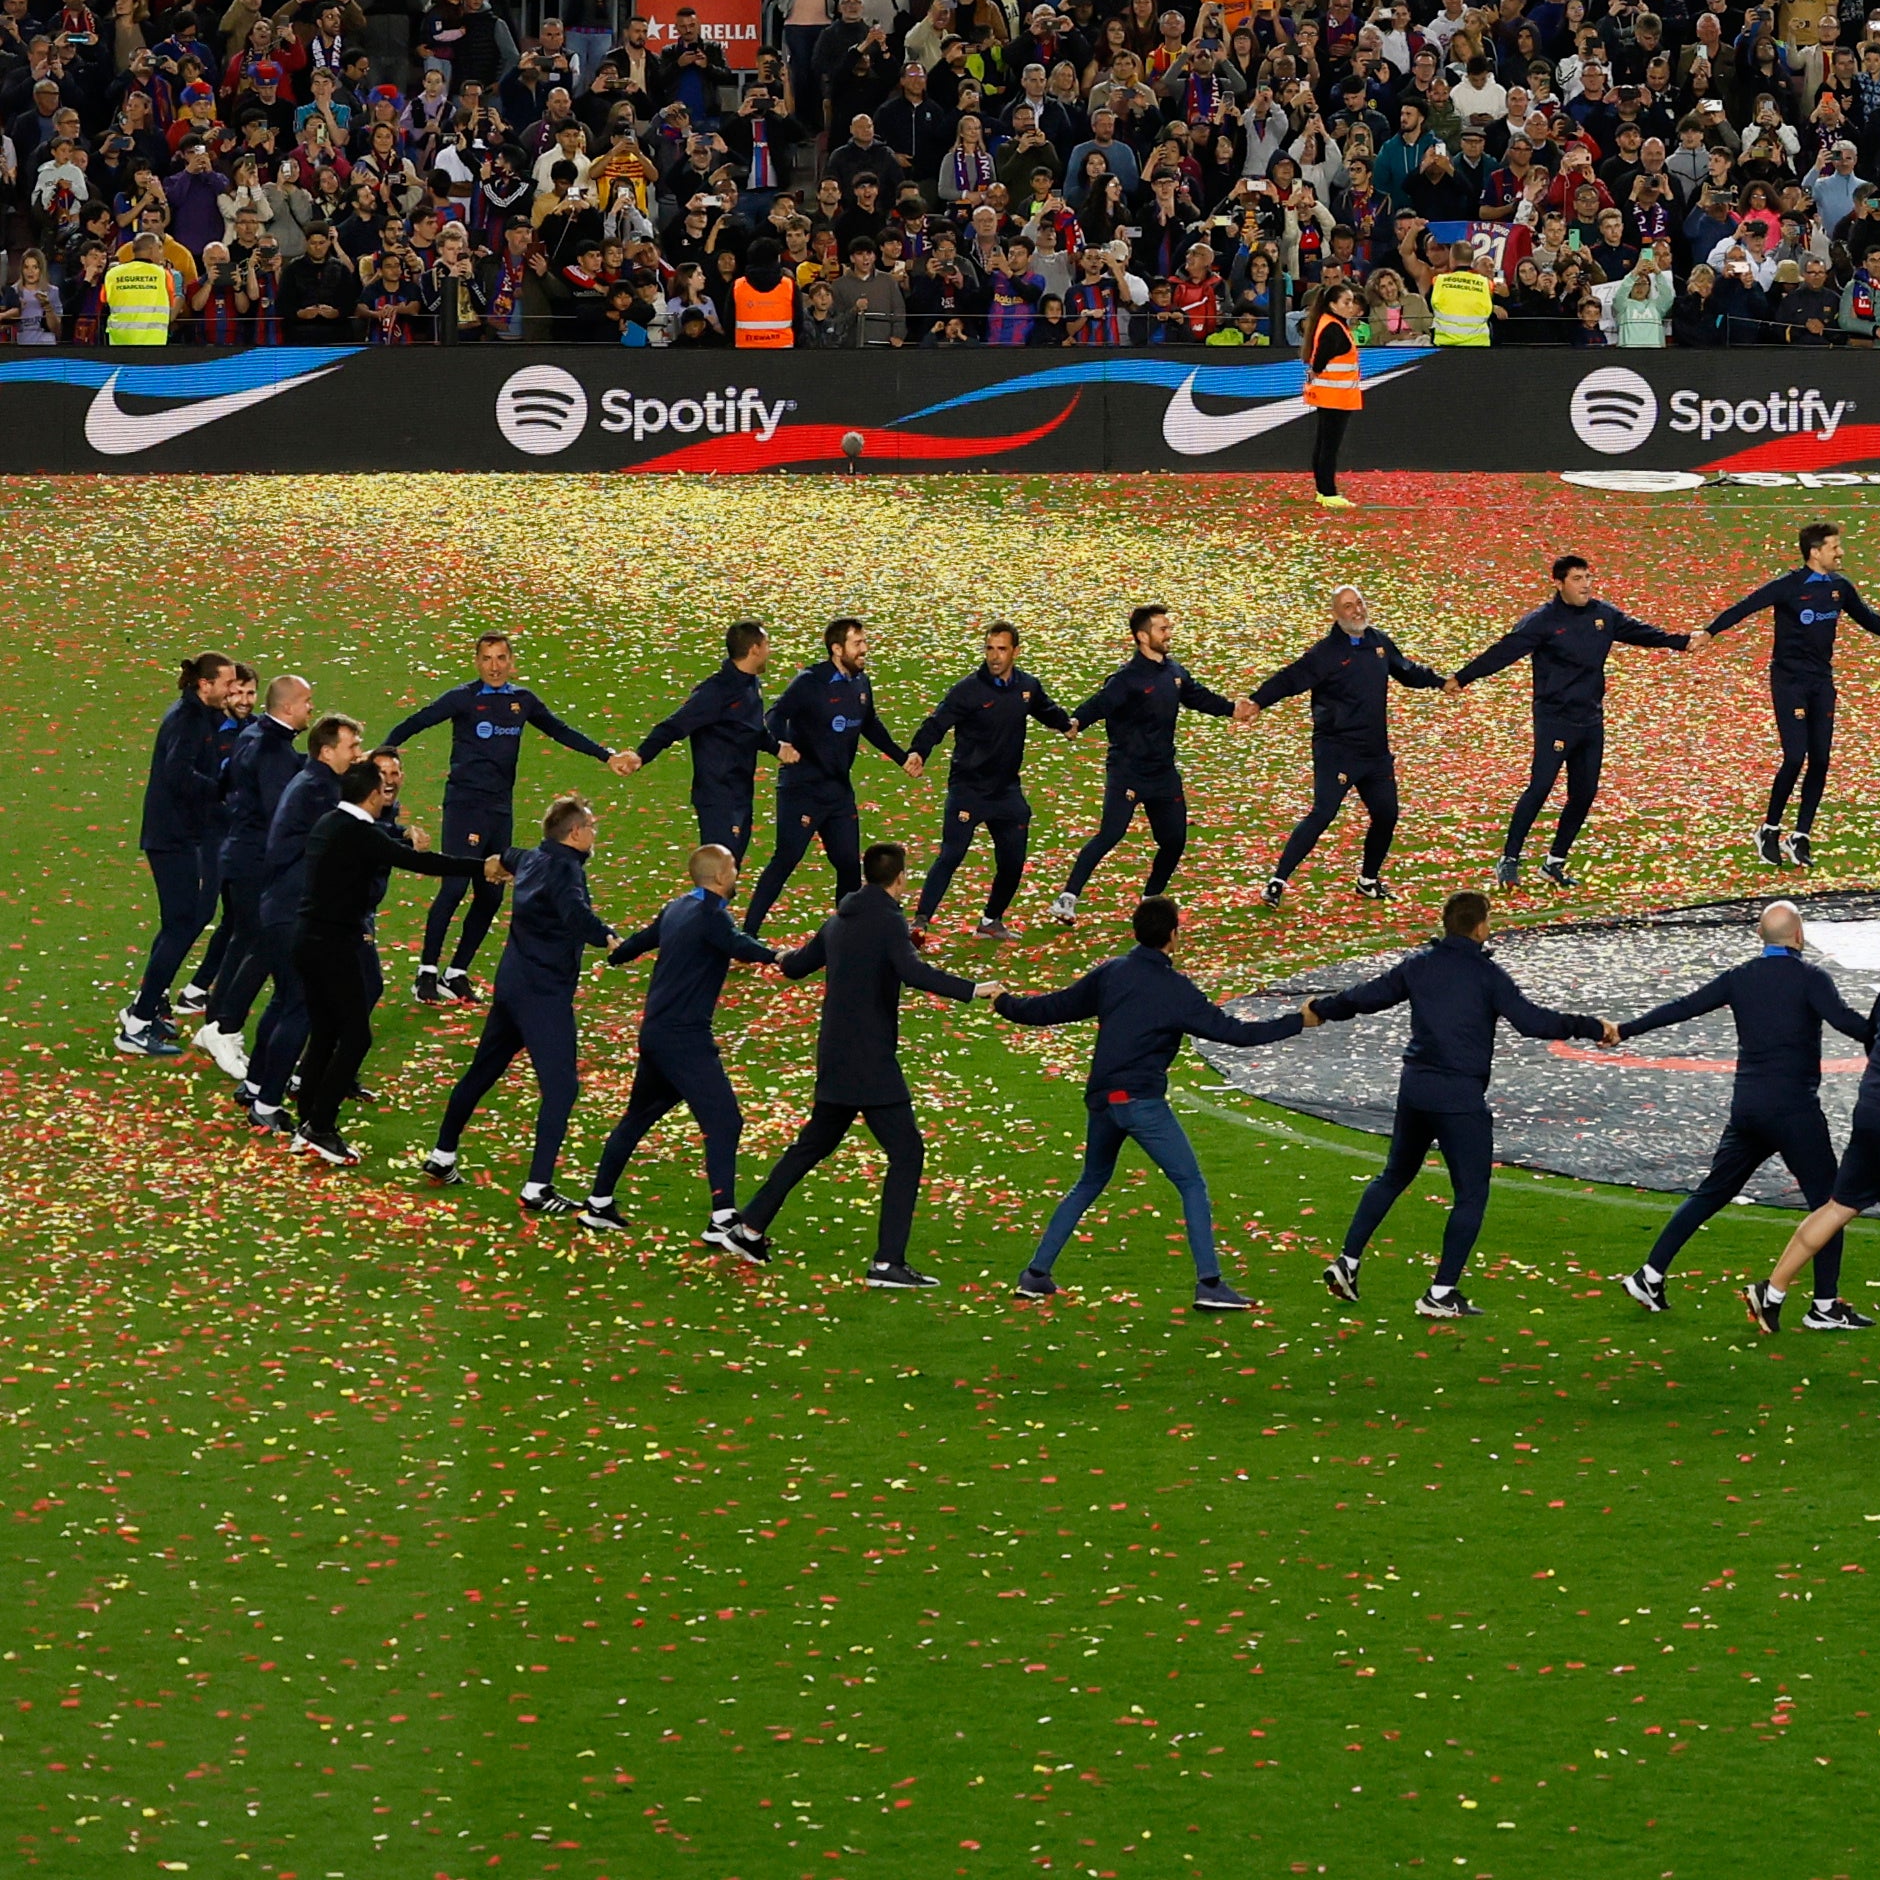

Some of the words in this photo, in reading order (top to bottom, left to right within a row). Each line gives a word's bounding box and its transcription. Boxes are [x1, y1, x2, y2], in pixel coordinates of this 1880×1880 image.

[667, 21, 758, 40] ERELLA
[1471, 233, 1505, 261] 21
[117, 275, 159, 284] SEGURETAT
[601, 387, 786, 442] Spotify
[1669, 387, 1846, 441] Spotify
